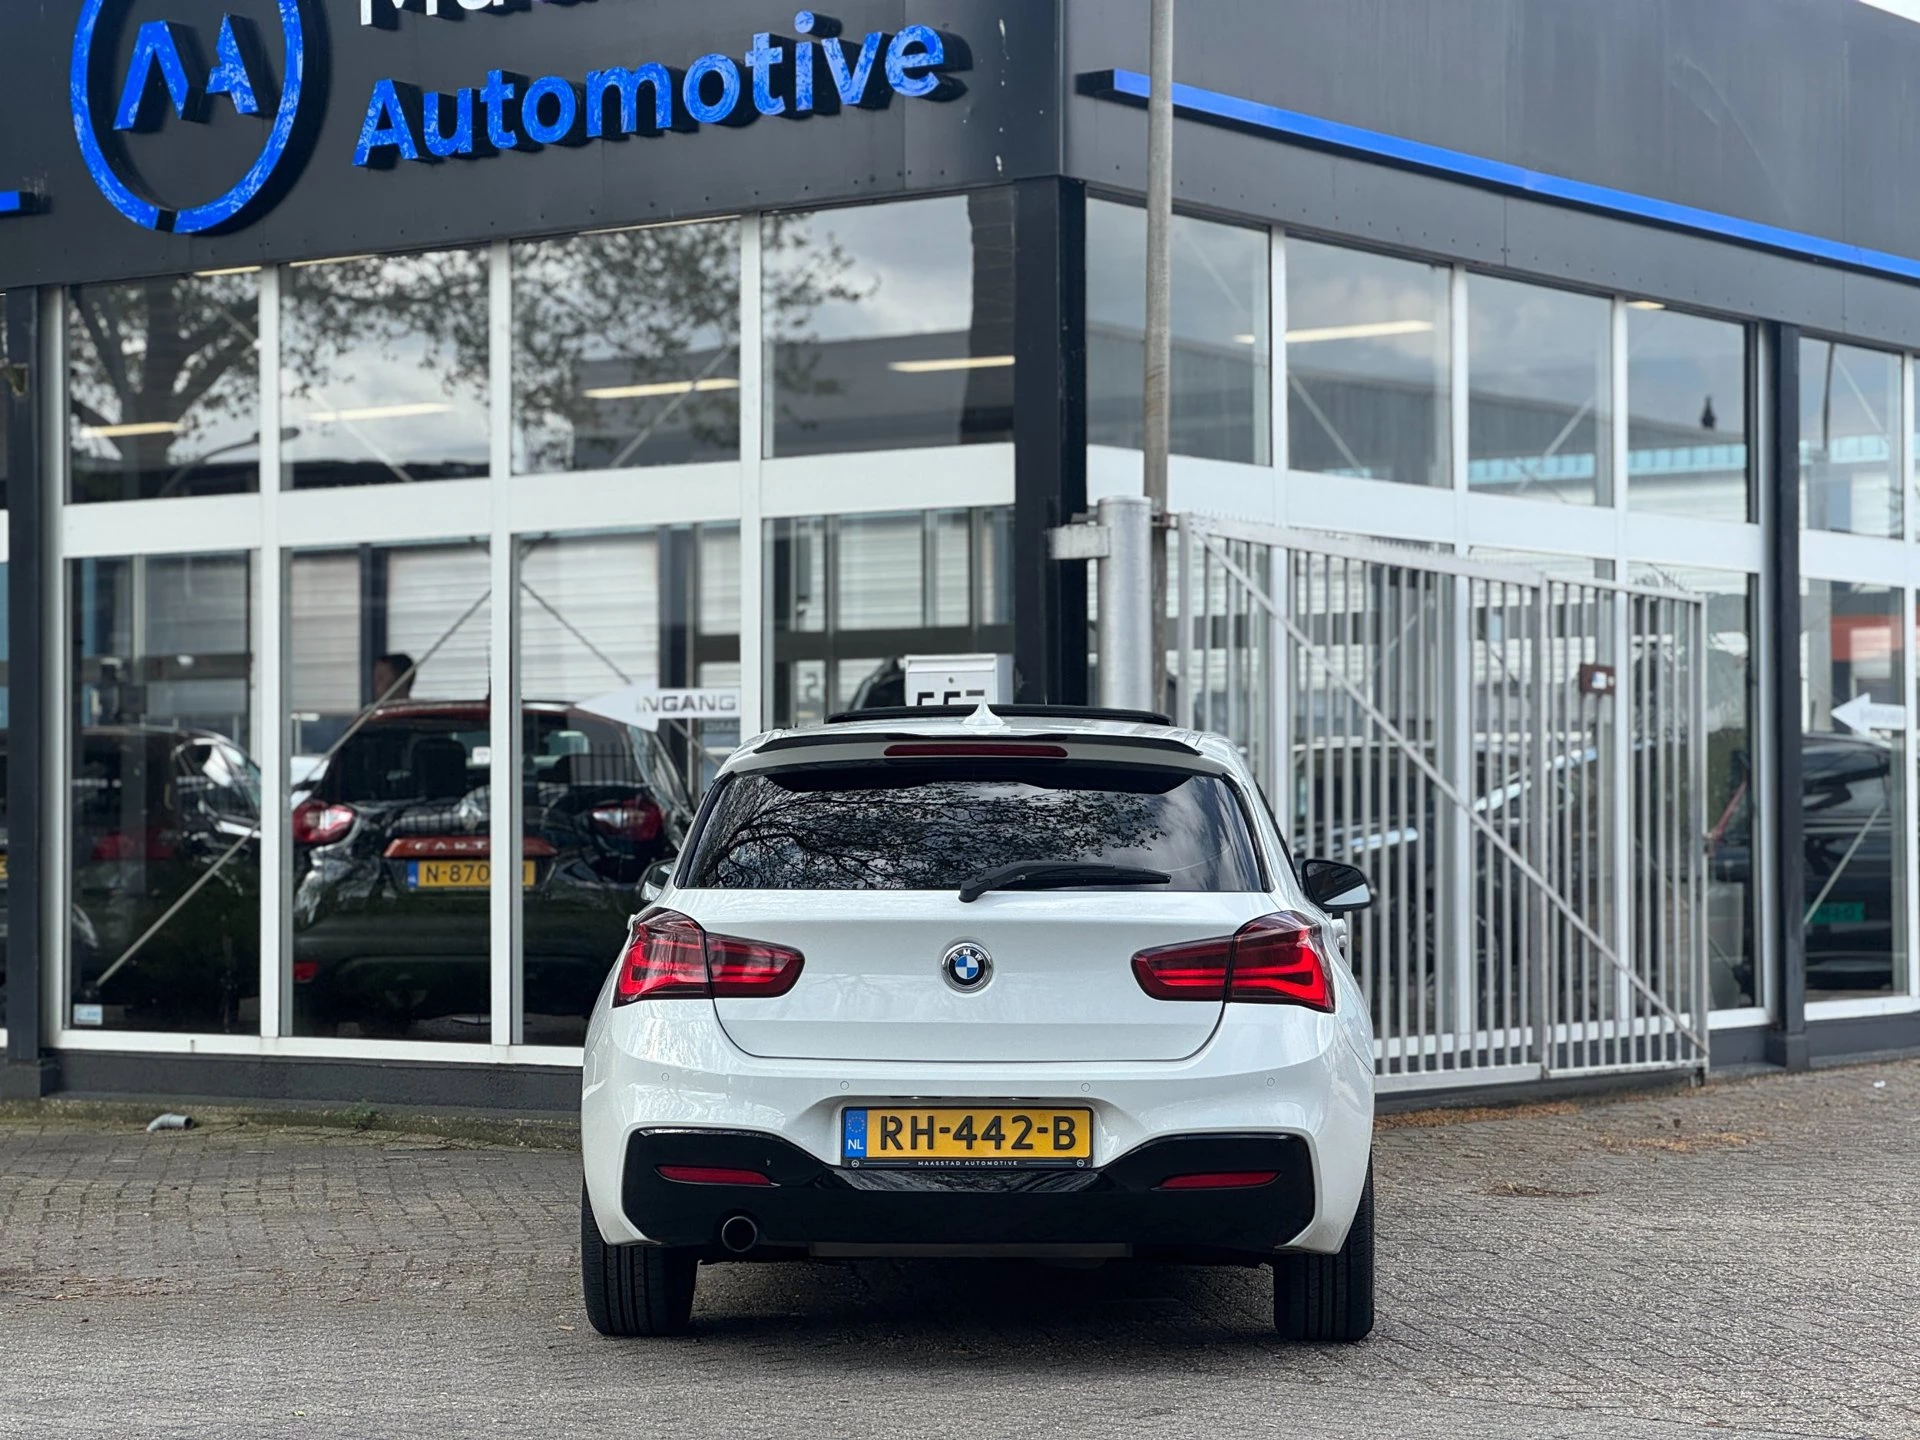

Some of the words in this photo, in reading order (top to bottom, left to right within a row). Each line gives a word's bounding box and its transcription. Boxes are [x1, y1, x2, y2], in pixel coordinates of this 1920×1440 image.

[352, 11, 945, 166] Automotive
[636, 695, 736, 712] INGANG
[950, 948, 983, 961] BMW
[880, 1114, 1076, 1151] RH-442-B
[847, 1138, 864, 1150] NL
